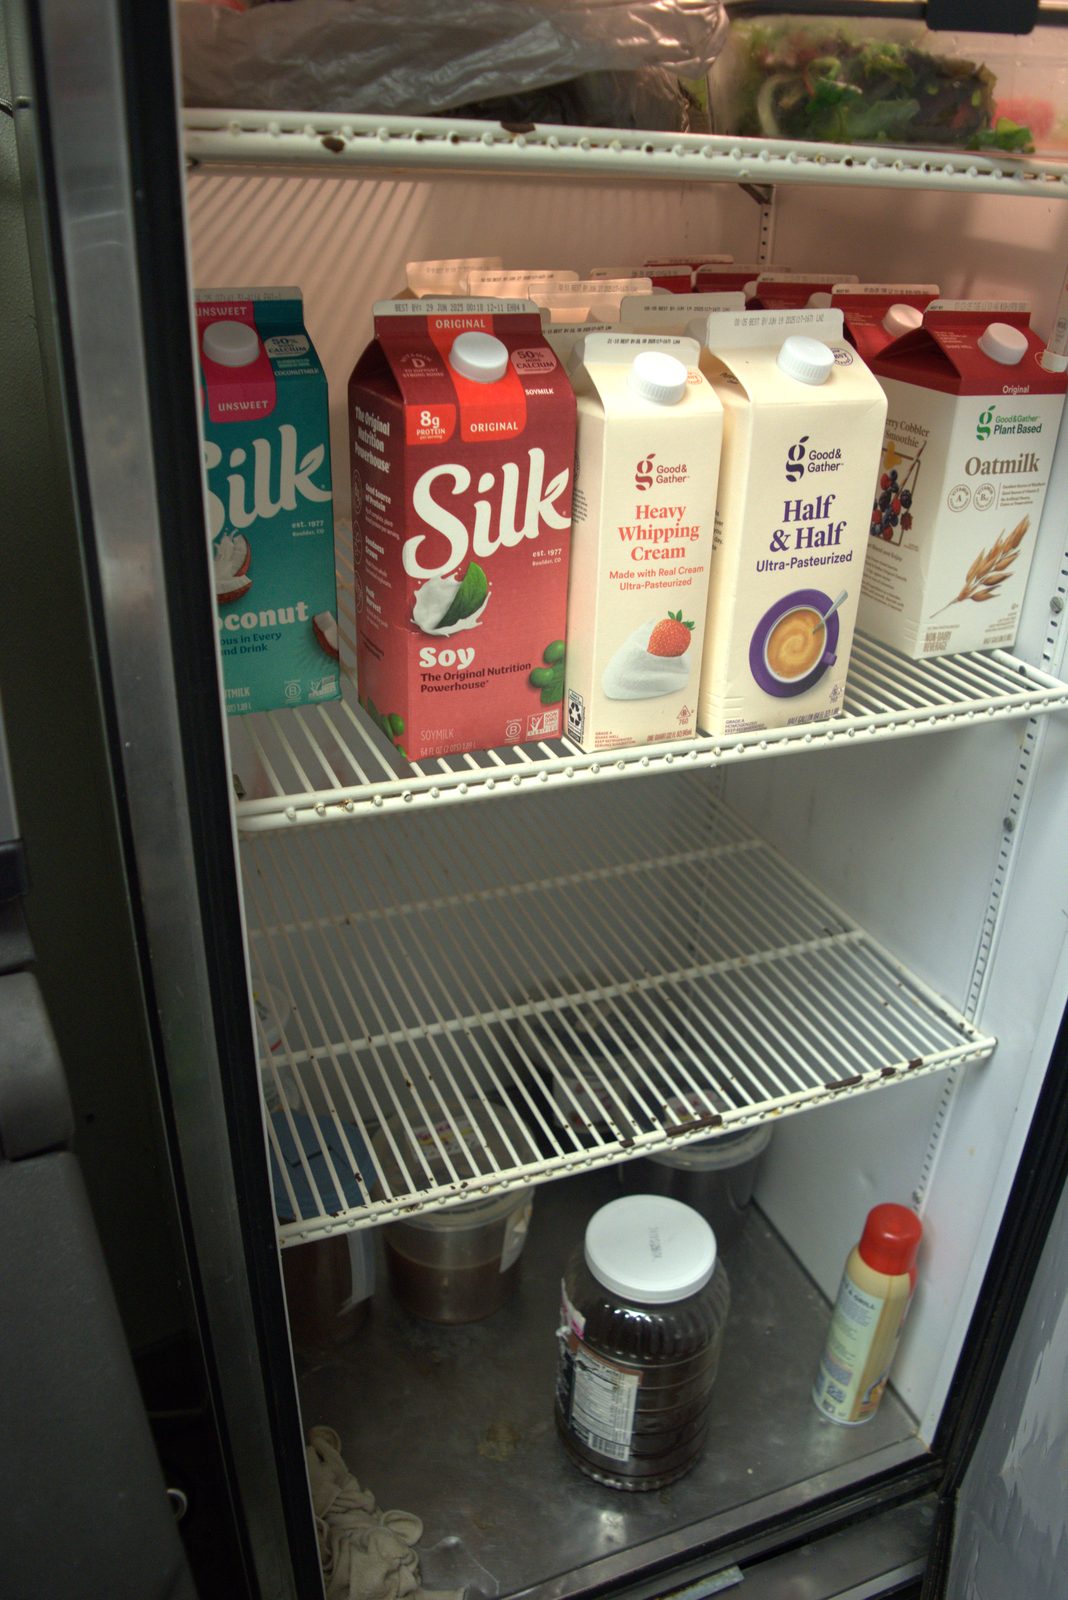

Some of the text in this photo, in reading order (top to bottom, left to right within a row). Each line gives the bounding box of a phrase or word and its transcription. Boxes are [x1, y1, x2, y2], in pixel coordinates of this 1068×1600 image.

[395, 303, 408, 312] BEST
[426, 303, 433, 312] 29
[437, 303, 448, 312] JUN
[450, 303, 463, 312] 2025
[435, 319, 486, 329] ORIGINAL
[517, 351, 544, 359] 50%
[516, 361, 554, 369] CALCIUM
[525, 388, 554, 396] SOYMILK
[1002, 385, 1030, 395] Original
[218, 401, 268, 412] UNSWEET
[420, 410, 440, 430] 8g
[995, 415, 1039, 423] Good&Gather
[416, 428, 446, 436] PROTEIN
[470, 422, 519, 432] ORIGINAL
[899, 420, 930, 438] Cobbler
[993, 423, 1042, 435] Plant Based
[808, 448, 842, 460] Good&
[656, 464, 687, 473] Good&
[807, 462, 840, 473] Gather
[965, 452, 1040, 476] Oatmilk
[656, 474, 687, 484] Gather
[402, 448, 572, 579] Silk
[635, 504, 686, 521] Heavy
[782, 494, 836, 523] Half
[292, 521, 307, 529] est.
[618, 523, 701, 544] Whipping
[769, 520, 847, 552] & Half
[532, 548, 562, 558] est. 1977
[631, 546, 686, 561] Cream
[756, 550, 853, 573] Ultra-Pasteurized
[609, 565, 704, 579] Made with Real Cream
[619, 577, 693, 591] Ultra-Pasteurized
[241, 634, 250, 643] in
[253, 631, 282, 642] Every
[240, 643, 268, 655] Drink
[419, 646, 475, 671] Soy
[421, 662, 532, 682] The Original Nutrition
[420, 728, 455, 740] SOYMILK
